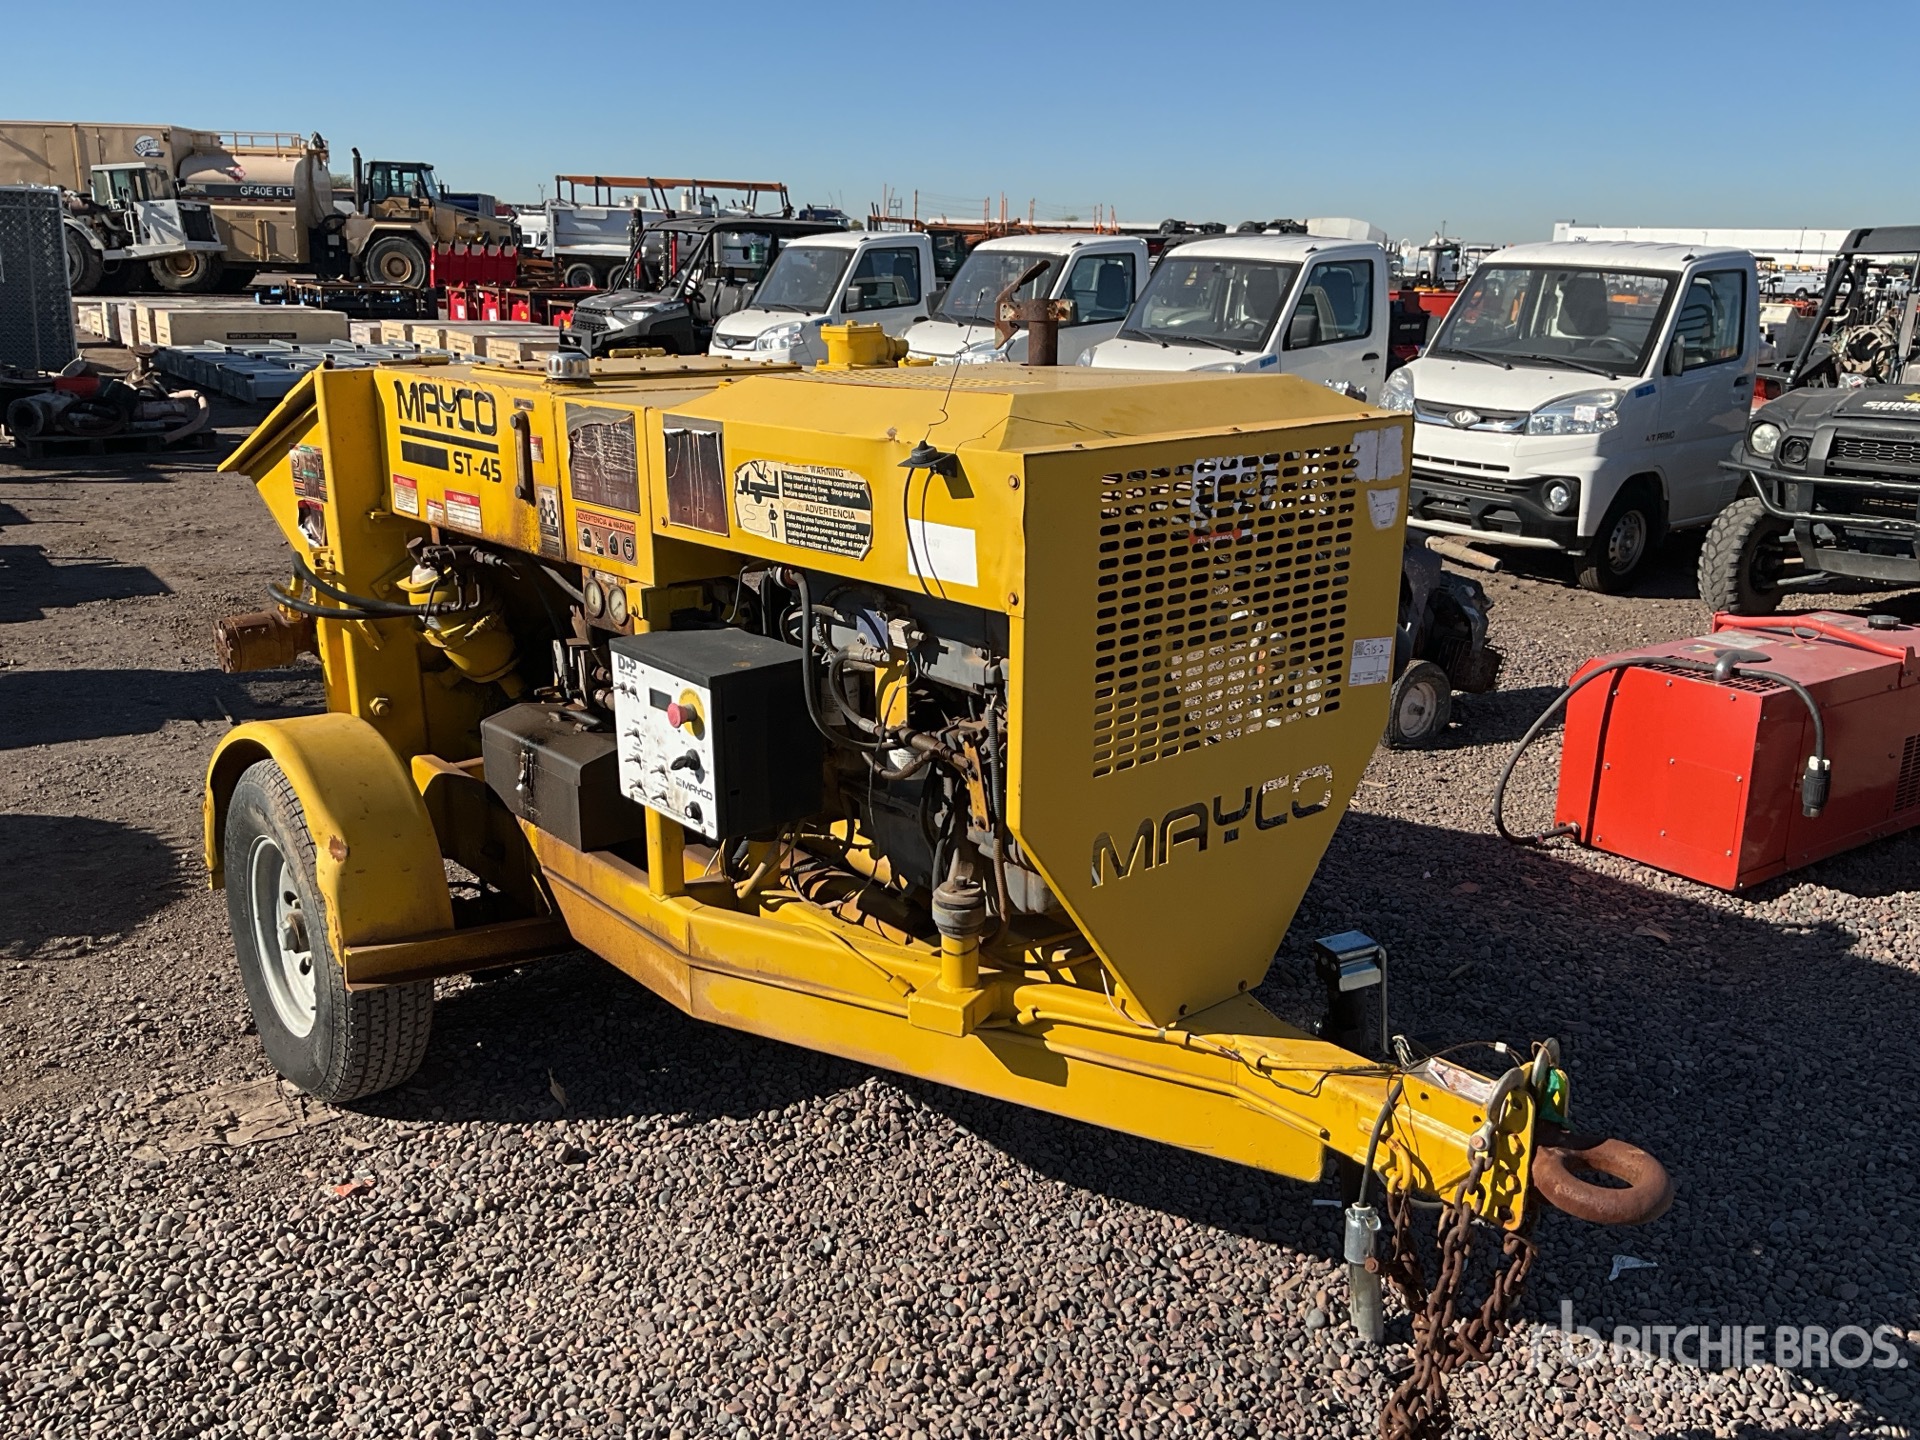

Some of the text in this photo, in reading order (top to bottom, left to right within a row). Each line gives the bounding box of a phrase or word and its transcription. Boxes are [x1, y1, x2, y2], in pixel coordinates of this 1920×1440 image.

[240, 186, 294, 197] GF40E FLT
[393, 380, 498, 436] MAYCO
[453, 451, 502, 483] ST-45
[809, 466, 844, 478] WARNING
[793, 474, 812, 483] machine
[833, 481, 859, 490] controlled
[831, 488, 843, 498] Stop
[805, 504, 856, 520] ADVERTENCIA
[577, 511, 635, 532] ADVERTENCIA WARNING
[846, 533, 865, 541] marcha
[682, 780, 713, 801] MAYCO
[1090, 763, 1334, 889] MAYCO
